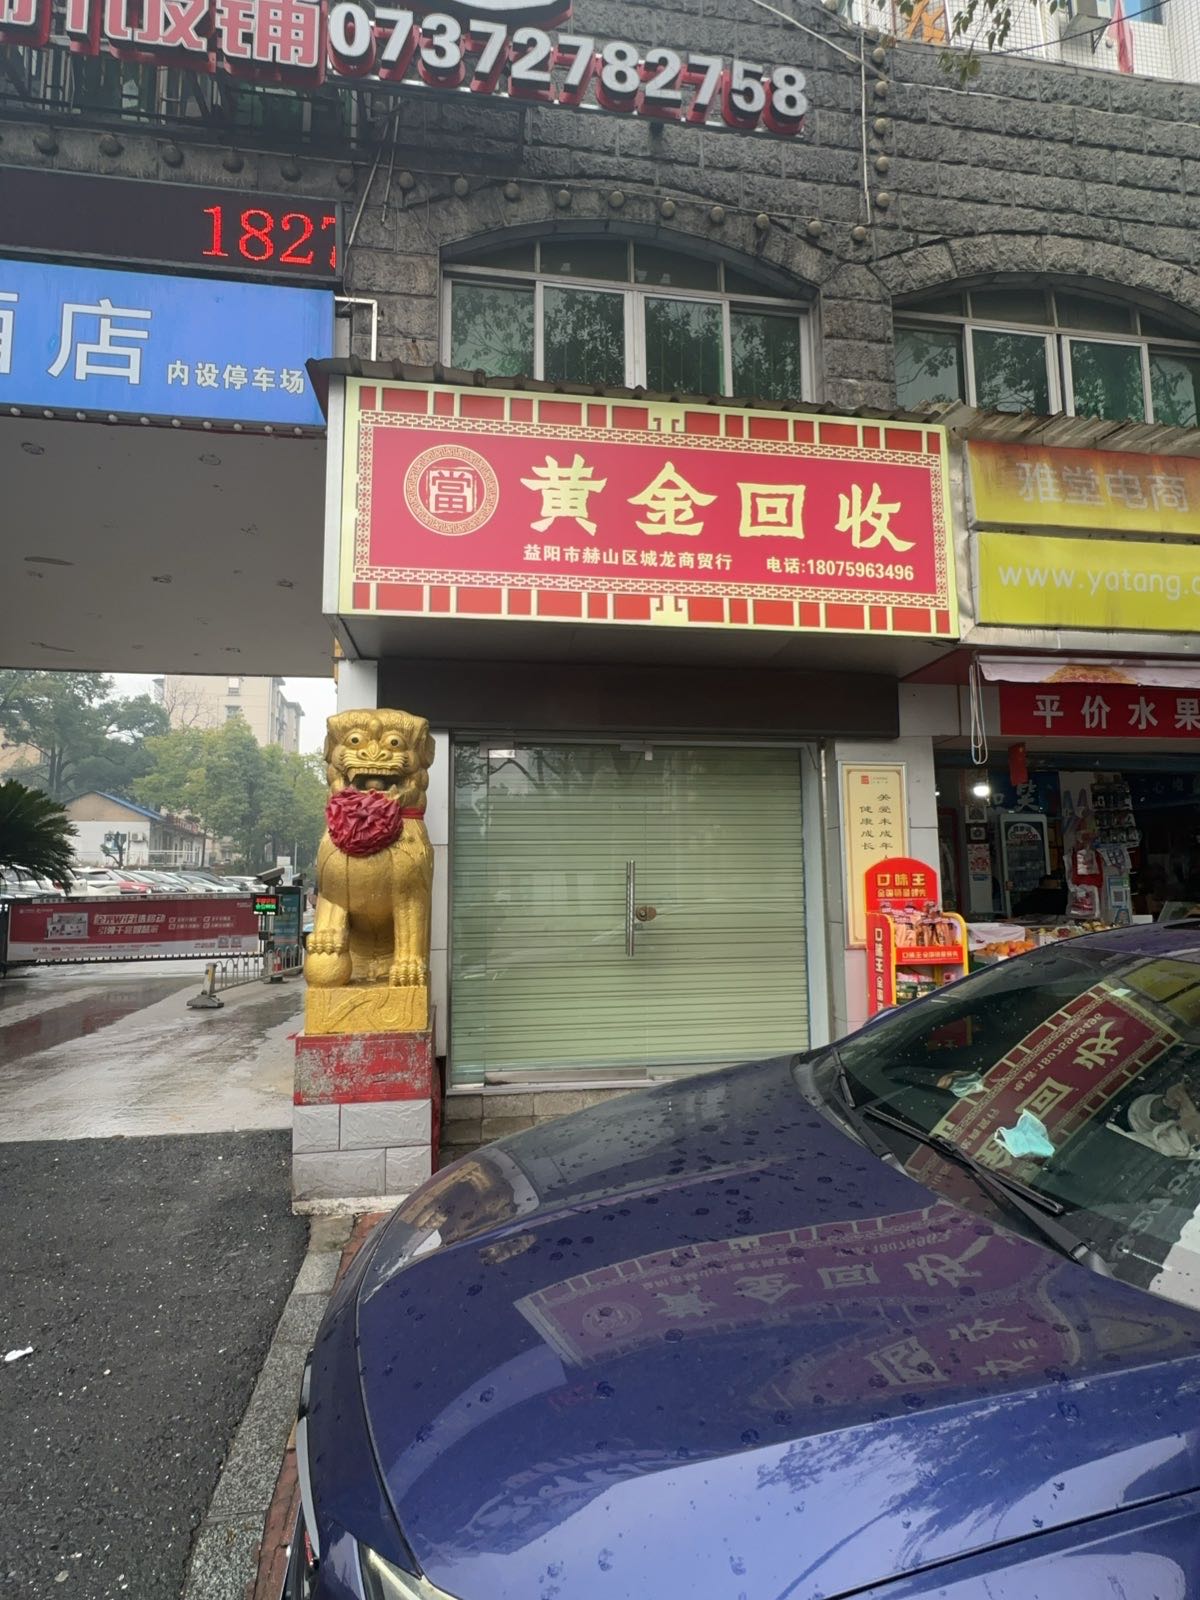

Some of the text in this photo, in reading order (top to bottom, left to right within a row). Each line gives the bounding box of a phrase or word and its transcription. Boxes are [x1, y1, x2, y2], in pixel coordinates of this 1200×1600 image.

[328, 3, 808, 118] 07372782758
[0, 292, 153, 384] 店
[167, 360, 305, 395] 内设停车场
[520, 453, 916, 552] 黄金回收
[1017, 461, 1190, 513] 雅堂电商
[523, 544, 733, 571] 益阳市赫山区城龙商贸行
[766, 556, 915, 581] 电话:18075963496
[1033, 694, 1200, 731] 平价水果
[876, 873, 926, 887] 口味王
